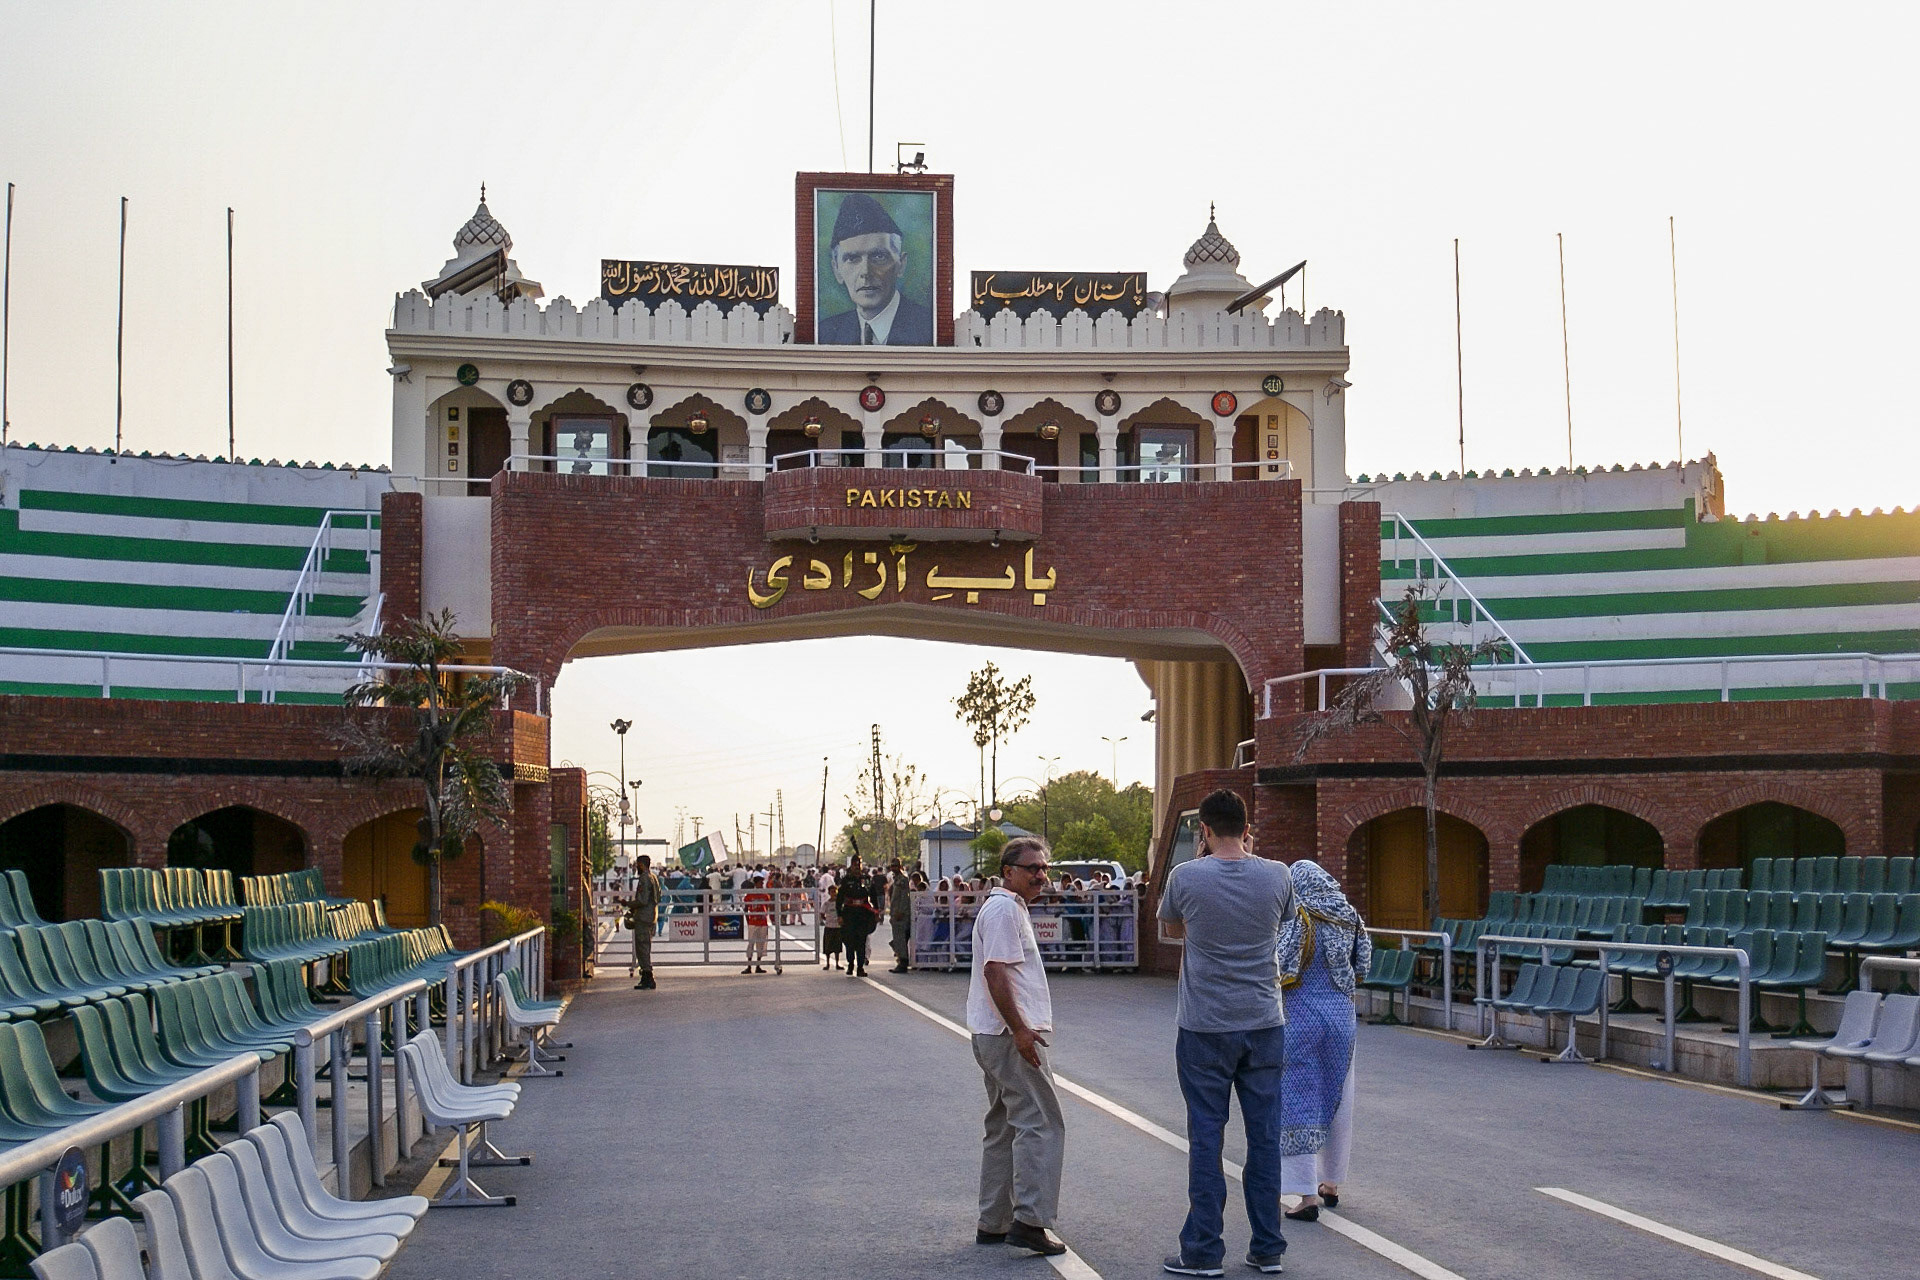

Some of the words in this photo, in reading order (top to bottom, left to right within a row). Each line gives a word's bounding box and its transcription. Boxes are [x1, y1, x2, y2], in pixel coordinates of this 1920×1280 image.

[973, 274, 996, 305] کیا
[990, 276, 1054, 305] مطلب
[1055, 276, 1074, 301] کا
[846, 488, 971, 509] PAKISTAN
[673, 920, 699, 928] THANK
[679, 929, 695, 937] YOU
